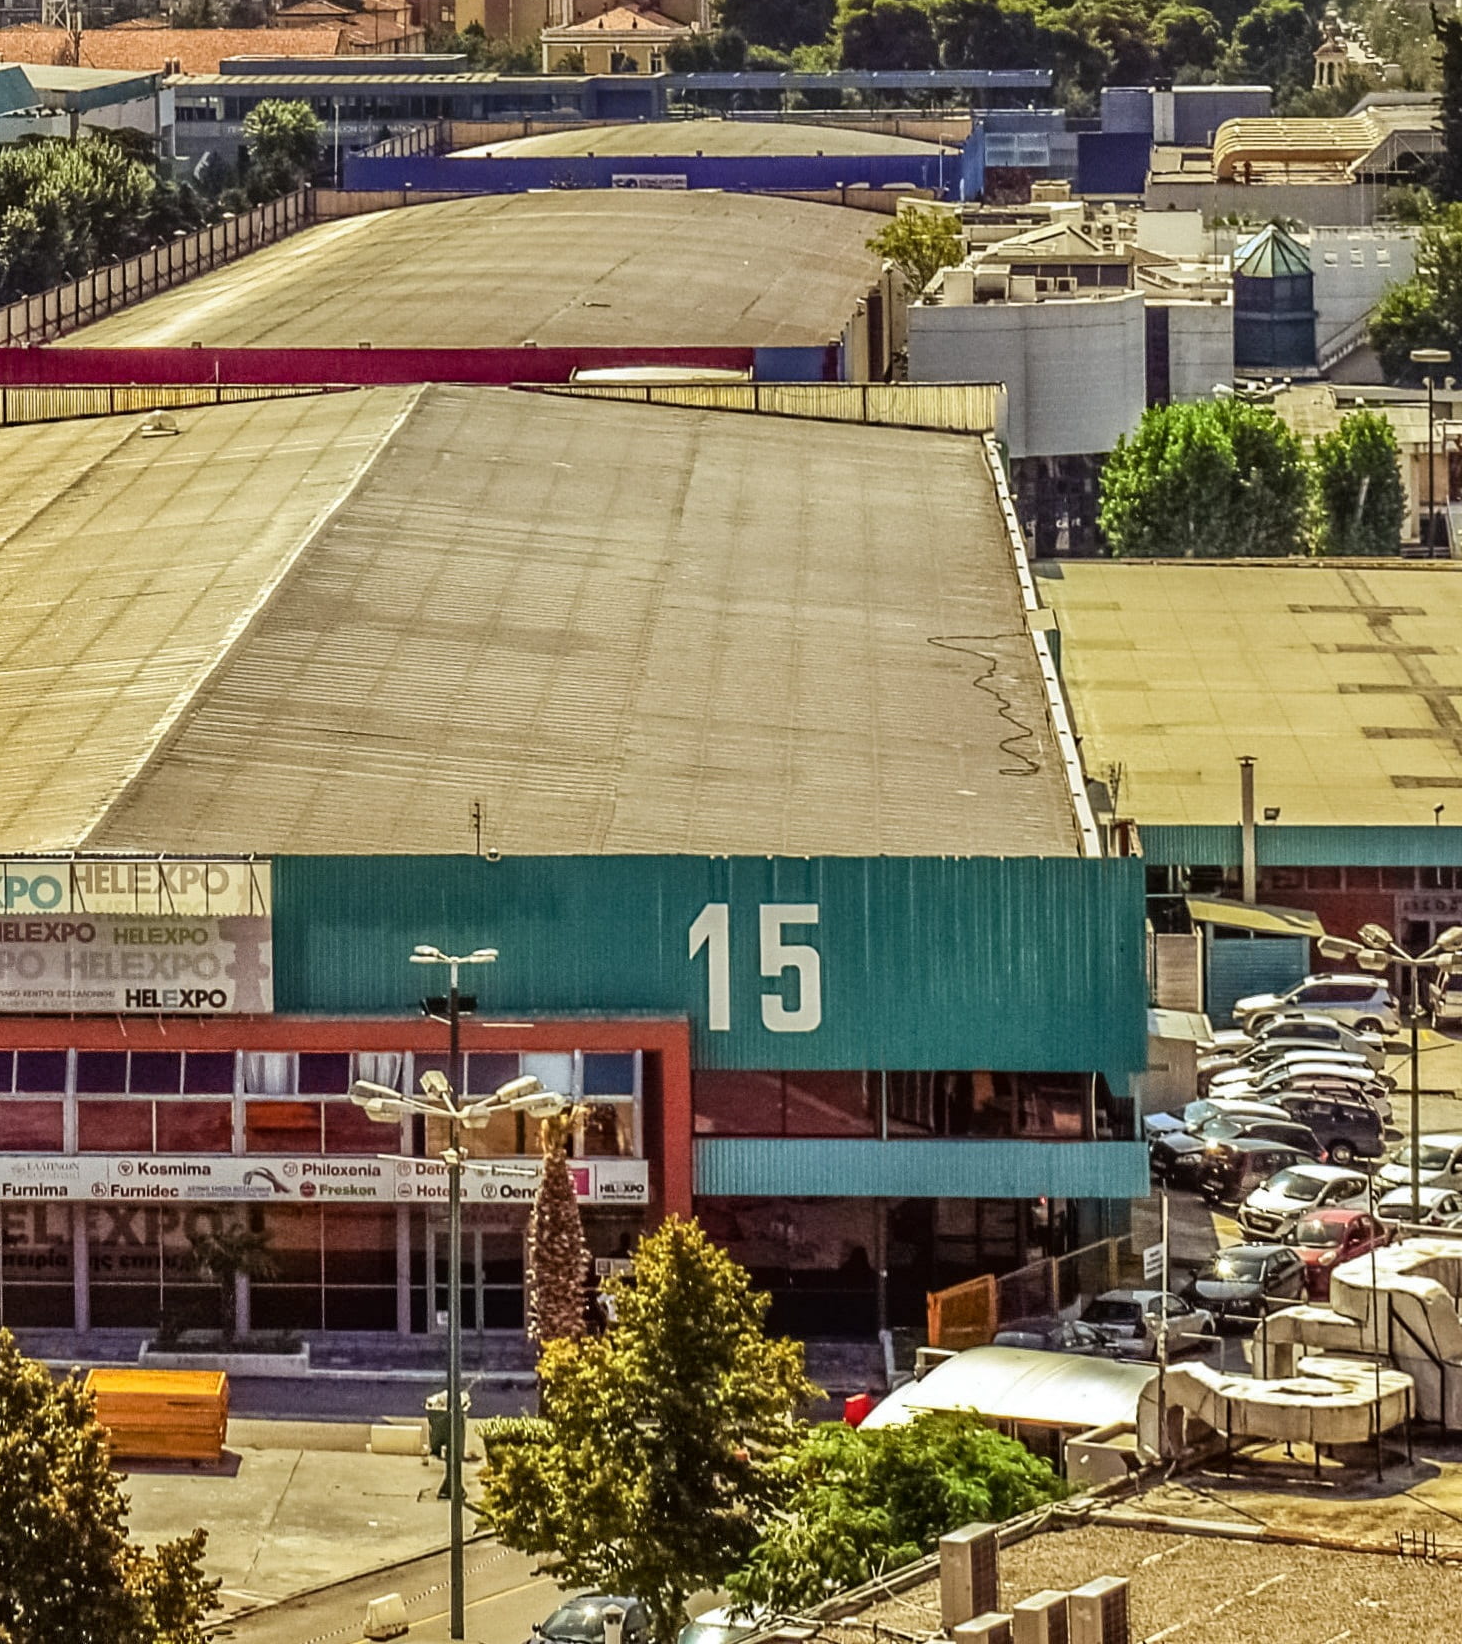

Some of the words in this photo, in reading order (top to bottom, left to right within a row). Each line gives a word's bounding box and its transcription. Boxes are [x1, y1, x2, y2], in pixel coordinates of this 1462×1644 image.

[70, 864, 230, 895] HELEXPO
[112, 926, 209, 946] HELEXPO
[689, 903, 822, 1033] 15
[125, 988, 227, 1009] HELEXPO
[138, 1162, 211, 1177] Kosmima
[302, 1163, 381, 1178] Philoxenia
[416, 1163, 466, 1176] Detrp
[2, 1183, 68, 1197] Furnima
[111, 1184, 179, 1198] Furnidec
[319, 1184, 377, 1197] Freskon
[417, 1184, 468, 1197] Hotea
